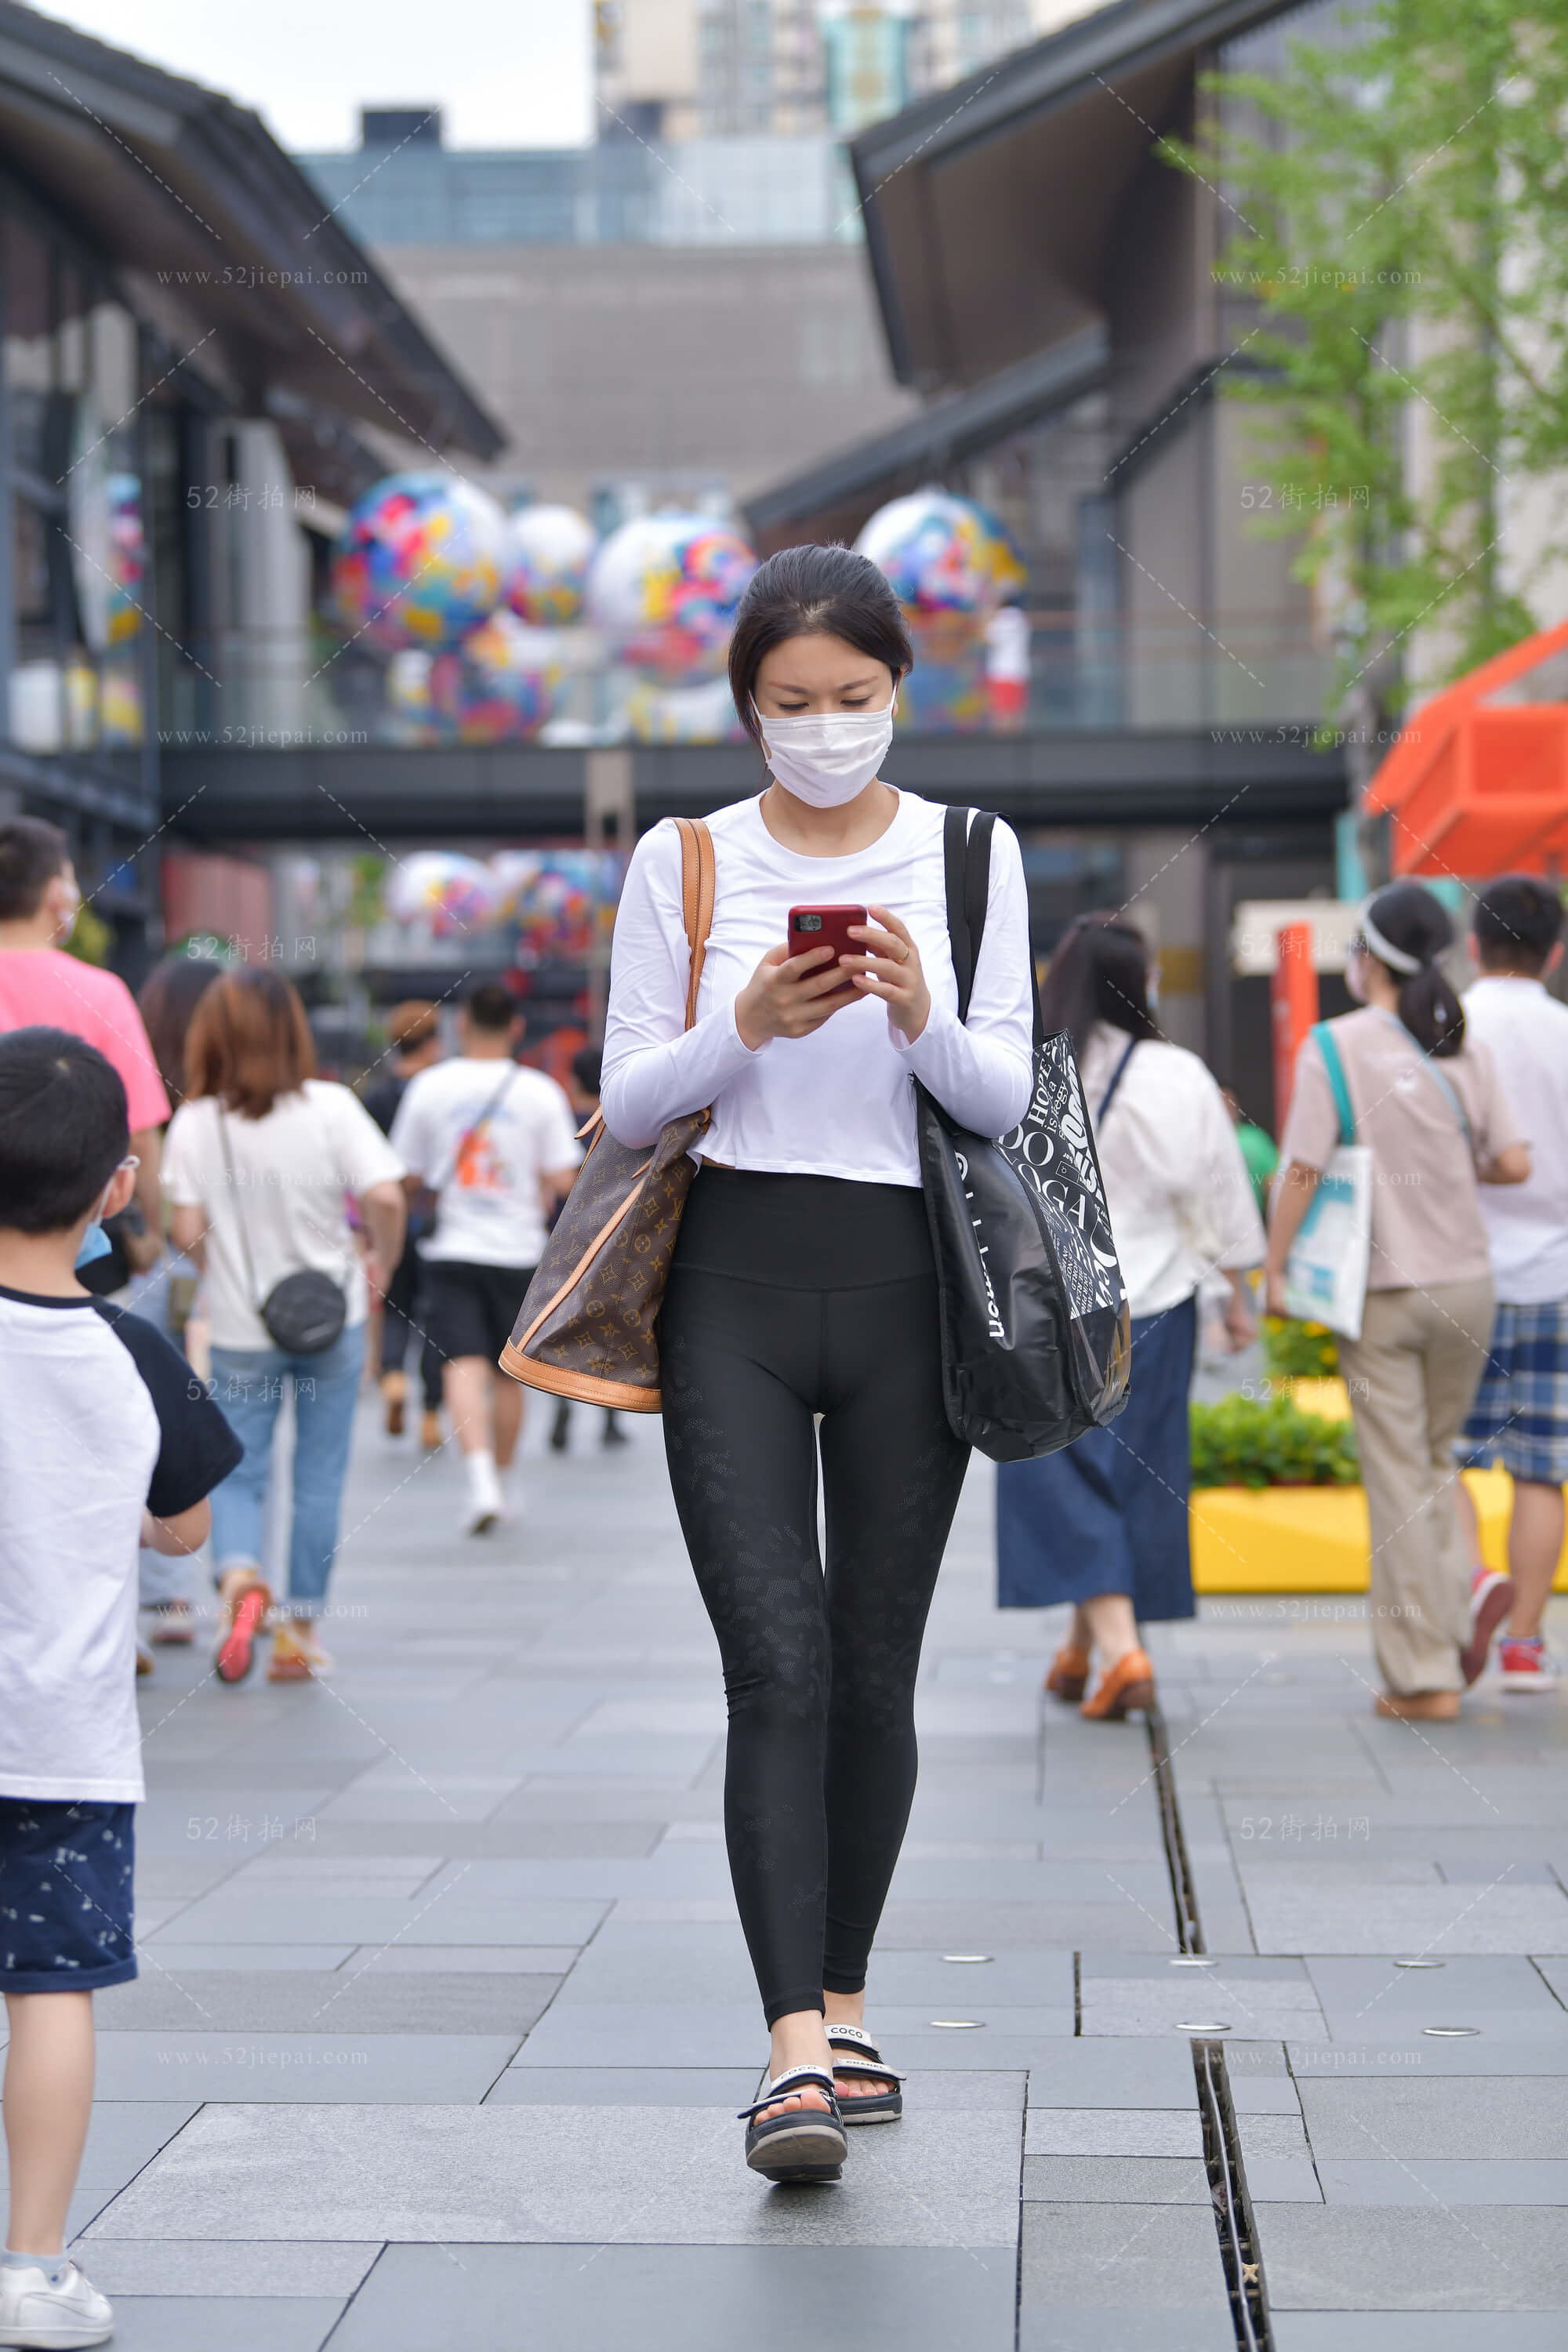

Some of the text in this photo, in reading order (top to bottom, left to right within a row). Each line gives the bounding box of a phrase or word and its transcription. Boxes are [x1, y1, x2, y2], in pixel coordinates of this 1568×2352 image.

[1026, 1058, 1051, 1127] HOPE
[830, 2026, 863, 2039] COCO
[845, 2060, 886, 2071] CHANEL
